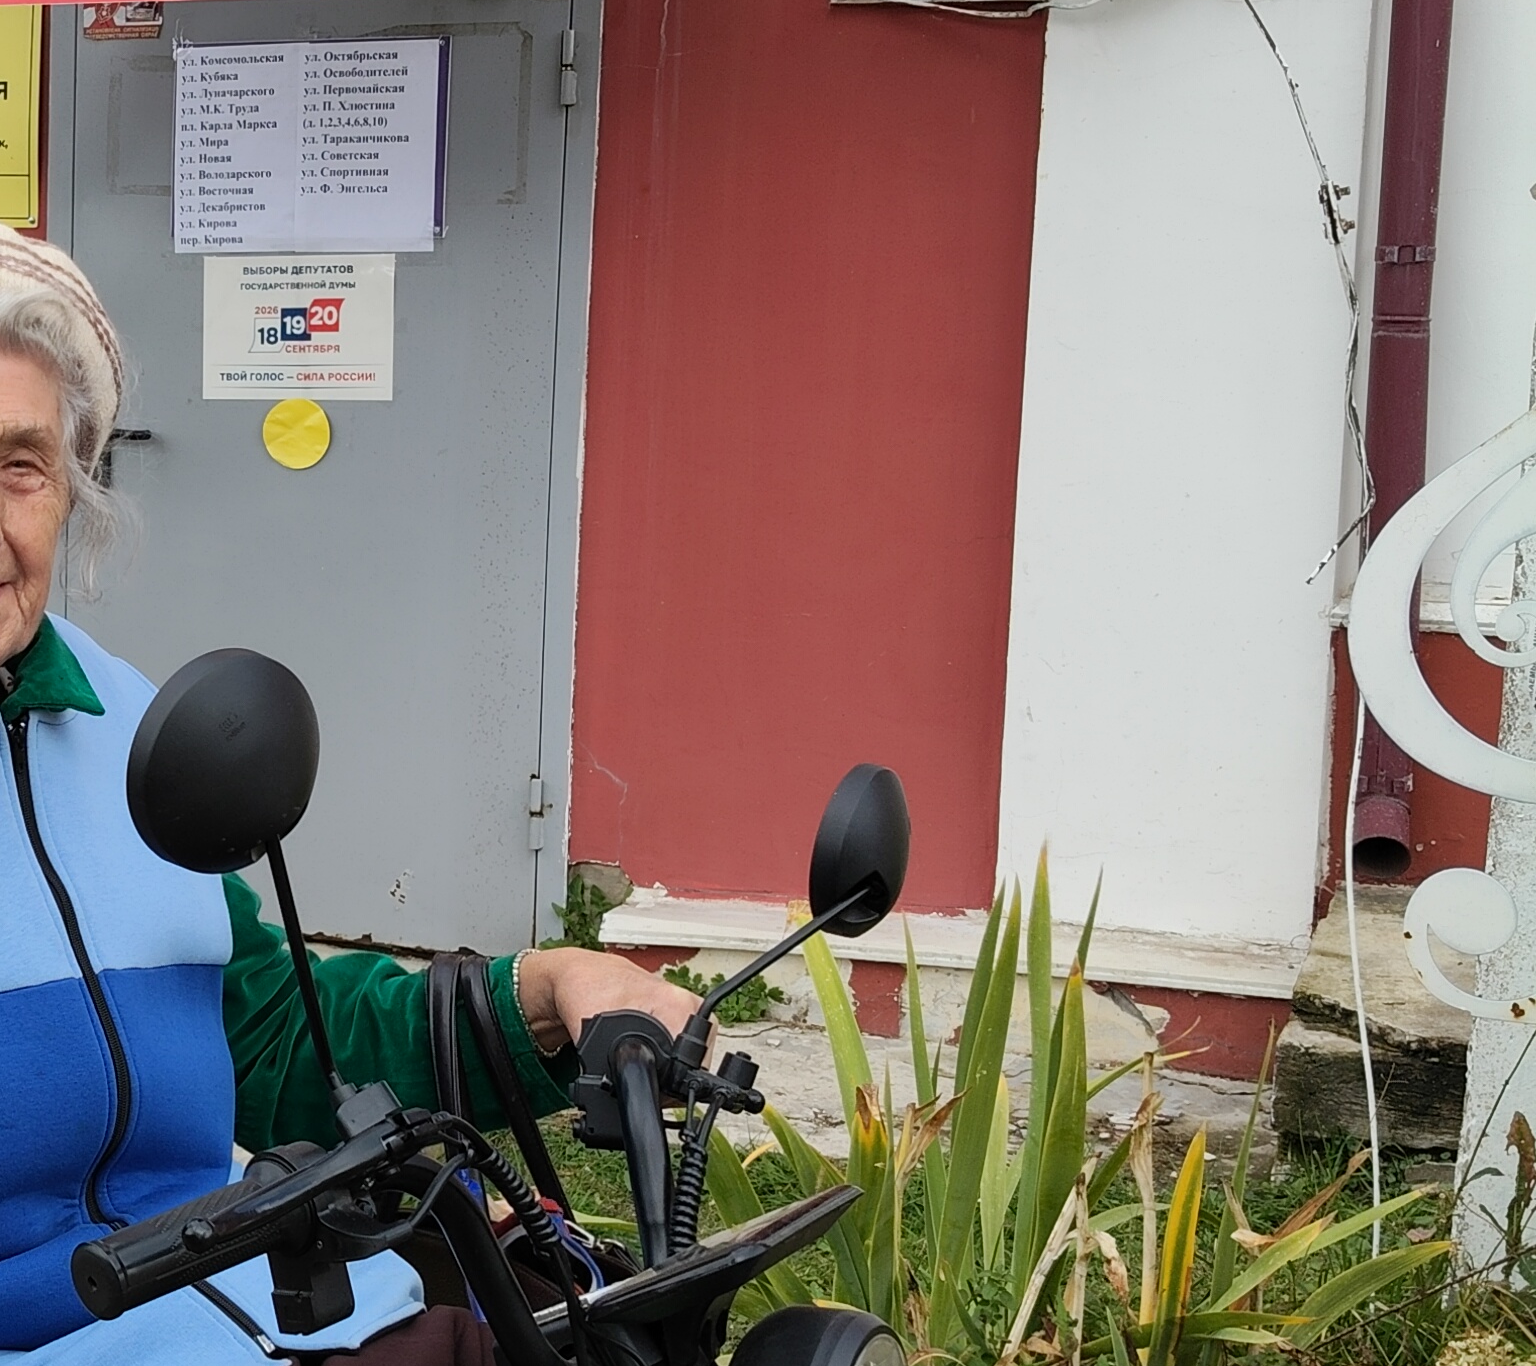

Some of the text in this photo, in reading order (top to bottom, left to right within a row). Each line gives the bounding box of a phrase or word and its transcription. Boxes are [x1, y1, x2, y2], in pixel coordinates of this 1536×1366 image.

[181, 54, 284, 69] ул. Комсомольская
[303, 50, 398, 65] ул. Октябрьская
[181, 71, 239, 86] ул. Кубяка
[303, 65, 409, 81] ул. Освободителей
[181, 87, 275, 102] ул. Луначарского
[303, 83, 405, 98] ул. Первомайская
[180, 107, 197, 118] ул.
[227, 103, 260, 116] Труда
[303, 100, 395, 115] ул. П. Хлюстина
[180, 119, 278, 134] пл. Карла Маркса
[180, 137, 229, 151] ул. Мира
[301, 133, 410, 147] ул. Тараканчикова
[180, 153, 232, 167] ул. Новая
[301, 150, 379, 163] ул. Советская
[180, 169, 272, 183] ул. Володарского
[301, 166, 389, 180] ул. Спортивная
[179, 186, 254, 199] ул. Восточная
[300, 183, 388, 197] ул. Ф. Энгельса
[179, 201, 266, 216] ул. Декабристов
[179, 218, 237, 232] ул. Кирова
[180, 234, 244, 248] пер. Кирова
[243, 264, 354, 276] ВЫБОРЫ ДЕПУТАТОВ
[240, 280, 356, 291] ГОСУДАРСТВЕННОЙ ДУМЫ
[254, 306, 279, 315] 2026
[257, 306, 339, 345] 18 19 20
[285, 344, 340, 354] СЕНТЯБРЯ
[219, 370, 248, 382] ТВОЙ
[250, 372, 285, 382] ГОЛОС
[296, 372, 326, 382] СИЛА
[327, 372, 377, 382] РОССИИ!
